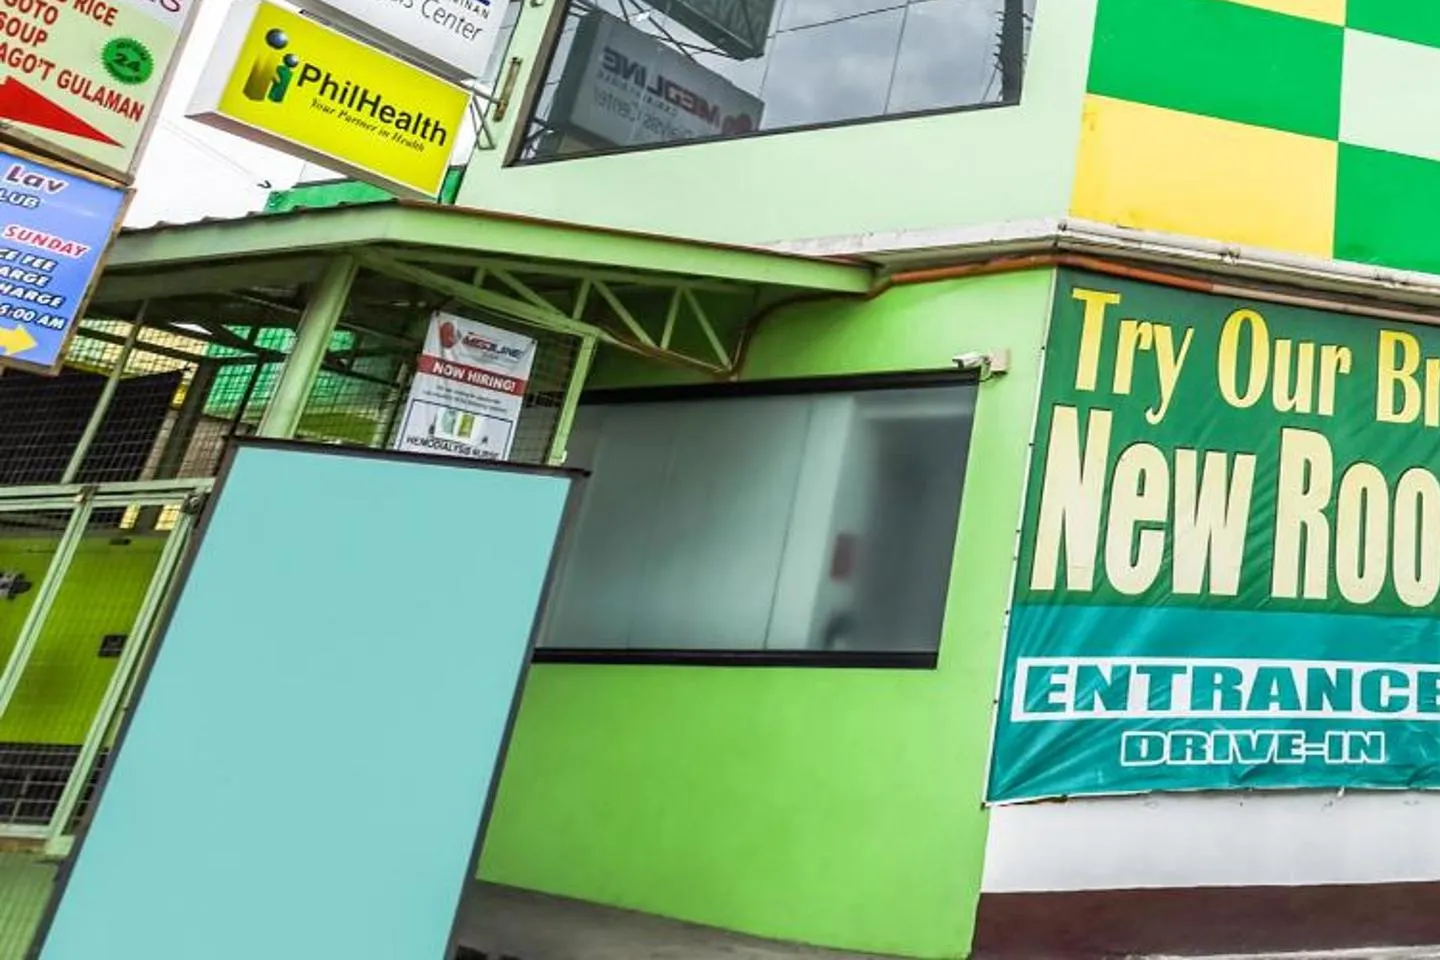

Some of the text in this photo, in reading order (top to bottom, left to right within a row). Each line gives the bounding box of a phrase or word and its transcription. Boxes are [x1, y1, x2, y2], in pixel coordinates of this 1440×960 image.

[56, 69, 146, 123] GULAMAN
[297, 62, 447, 147] PhilHealth
[311, 97, 336, 115] Your
[337, 107, 377, 133] Partner
[391, 130, 425, 153] Health
[7, 165, 66, 192] Lav
[4, 225, 88, 258] SUNDAY
[36, 314, 66, 330] AM
[432, 360, 516, 393] NOW HIRING!
[1072, 287, 1194, 425] Try
[1217, 308, 1352, 418] Our
[1029, 404, 1257, 597] New
[1120, 729, 1386, 767] DRIVE-IN
